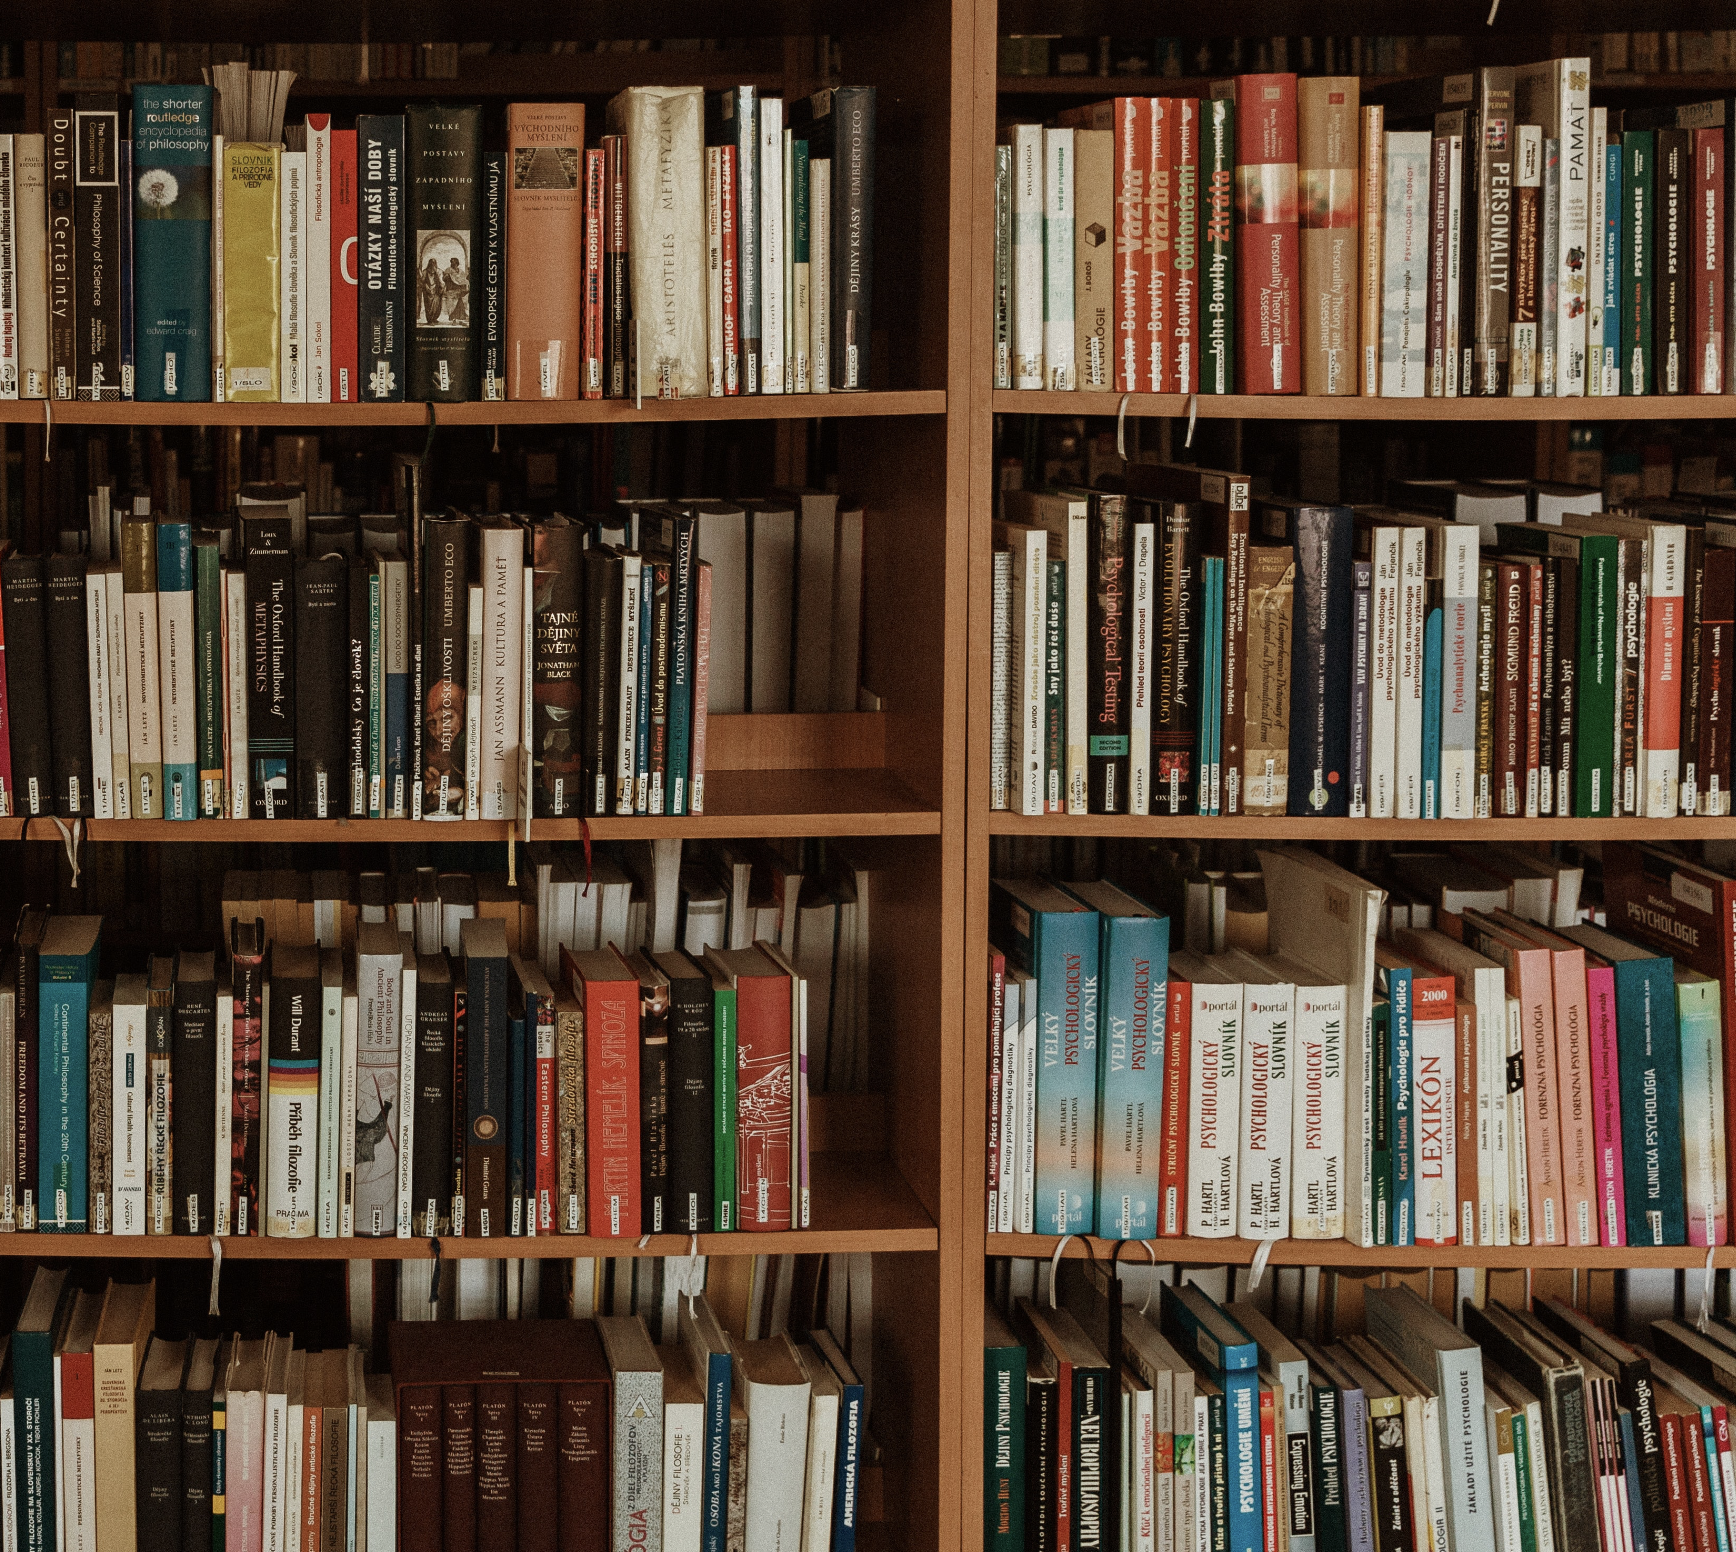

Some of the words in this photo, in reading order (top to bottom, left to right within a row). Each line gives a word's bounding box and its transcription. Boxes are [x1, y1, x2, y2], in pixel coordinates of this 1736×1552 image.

[143, 99, 160, 109] the
[162, 99, 202, 109] shorter
[147, 112, 200, 124] routledge
[852, 110, 861, 133] ECO
[136, 139, 147, 149] of
[149, 139, 209, 152] philosophy
[139, 126, 207, 137] encyclopedia
[428, 122, 460, 130] VELKÉ
[53, 119, 69, 181] Doubt
[367, 138, 382, 181] DOBY
[662, 103, 673, 210] METAFYZIKA
[852, 134, 861, 196] UMBERTO
[243, 181, 262, 189] VEDY
[415, 176, 473, 184] ZÁPADNÍHO
[93, 193, 102, 248] Philosophy
[364, 187, 382, 224] NAŠÍ
[422, 202, 466, 211] MYŠLENÍ
[614, 183, 622, 246] WITTGENSTEIN
[1117, 169, 1143, 254] Vazba
[1144, 170, 1170, 255] Vazba
[1173, 165, 1196, 270] Odloučení
[1207, 170, 1230, 243] Ztráta
[850, 206, 861, 247] KRÁSY
[1488, 162, 1510, 293] PERSONALITY
[1607, 231, 1615, 257] stres
[1634, 187, 1643, 277] PSYCHOLOGIE
[1668, 183, 1677, 274] PSYCHOLOGIE
[1706, 189, 1715, 270] PSYCHOLOGIE
[52, 216, 71, 317] Certainty
[94, 250, 102, 264] of
[364, 231, 382, 290] OTÁZKY
[849, 248, 861, 294] DĚJINY
[1269, 234, 1283, 289] Personality
[1606, 259, 1616, 290] zvládat
[93, 266, 101, 307] Science
[1120, 269, 1139, 330] Bowlby
[1147, 269, 1165, 331] Bowlby
[1209, 253, 1227, 313] Bowlby
[1606, 291, 1615, 308] Jak
[384, 300, 393, 355] TRESMONTANT
[1174, 278, 1194, 337] Bowlby
[1260, 287, 1270, 347] Assessment
[1270, 290, 1281, 325] Theory
[146, 327, 175, 335] edward
[177, 327, 197, 337] craig
[371, 324, 381, 354] CLAUDE
[1209, 314, 1225, 354] John
[249, 547, 289, 555] Zimmerman
[444, 542, 455, 566] ECO
[1139, 536, 1148, 567] Drapela
[1388, 541, 1396, 579] Ferjenčík
[272, 579, 284, 602] The
[1138, 578, 1146, 601] Victor
[1139, 569, 1147, 577] J.
[443, 568, 454, 627] UMBERTO
[497, 600, 506, 608] A
[540, 612, 578, 623] TAJNÉ
[628, 588, 636, 622] MYŠLENÍ
[1048, 601, 1059, 628] duše
[1098, 556, 1124, 666] Psychological
[1508, 584, 1521, 624] FREUD
[271, 603, 284, 643] Oxford
[496, 612, 506, 666] KULTURA
[537, 627, 580, 639] DĚJINY
[1048, 630, 1059, 647] řeč
[1625, 581, 1639, 659] psychologie
[255, 601, 267, 692] METAPHYSICS
[537, 662, 580, 671] JONATHAN
[541, 642, 577, 654] SVĚTA
[626, 626, 634, 673] DESTRUKCE
[1048, 649, 1059, 673] jako
[1506, 626, 1520, 681] SIGMUND
[1660, 641, 1673, 681] Dimenze
[272, 645, 285, 703] Handbook
[442, 637, 454, 708] OŠKLIVOSTI
[1048, 676, 1058, 696] Sny
[270, 704, 285, 720] of
[495, 676, 505, 736] ASSMANN
[625, 685, 633, 742] FINKIELKRAUT
[1098, 667, 1123, 724] Testing
[441, 709, 451, 752] DĚJINY
[495, 740, 505, 762] JAN
[290, 995, 303, 1015] Will
[1064, 952, 1081, 1066] PSYCHOLOGICKÝ
[1082, 975, 1097, 1049] SLOVNÍK
[1208, 1001, 1237, 1012] portál
[1397, 980, 1407, 1015] řidiče
[1421, 989, 1447, 1002] 2000
[61, 1003, 70, 1053] Continental
[290, 1017, 302, 1052] Durant
[1044, 1012, 1060, 1067] VELKÝ
[1398, 1016, 1411, 1038] pro
[1532, 1003, 1546, 1070] PSYCHOLÓGIA
[18, 1040, 27, 1090] FREEDOM
[1217, 1019, 1236, 1077] SLOVNÍK
[59, 1055, 70, 1104] Philosophy
[541, 1063, 550, 1102] Eastern
[1198, 1040, 1219, 1150] PSYCHOLOGICKÝ
[1396, 1039, 1411, 1111] Psychologie
[1535, 1071, 1548, 1120] FORENZNÁ
[18, 1090, 27, 1113] AND
[61, 1106, 69, 1115] in
[288, 1101, 302, 1141] Příběh
[1416, 1055, 1443, 1180] LEXIKÓN
[18, 1114, 27, 1132] ITS
[61, 1117, 69, 1131] the
[61, 1133, 69, 1152] 20th
[540, 1104, 550, 1157] Philosophy
[18, 1132, 27, 1182] BETRAYAL
[57, 1153, 69, 1189] Century
[287, 1144, 302, 1193] filozofie
[995, 1370, 1011, 1432] PSYCHOLOGIE
[1233, 1388, 1252, 1429] UMĚNÍ
[1459, 1370, 1472, 1436] PSYCHOLOGIE
[1635, 1379, 1658, 1454] psychologie
[711, 1436, 722, 1472] IKONA
[995, 1434, 1011, 1468] DĚJINY
[1289, 1439, 1305, 1490] Expressing
[713, 1473, 721, 1489] AKO
[1080, 1415, 1100, 1548] NEUROPHILOSOPHY
[1238, 1431, 1254, 1513] PSYCHOLOGIE
[1323, 1465, 1340, 1505] Přehled
[1466, 1471, 1477, 1514] ZÁKLADY
[709, 1490, 720, 1527] OSOBA
[843, 1462, 855, 1528] AMERICKÁ
[1294, 1492, 1309, 1530] Emotion
